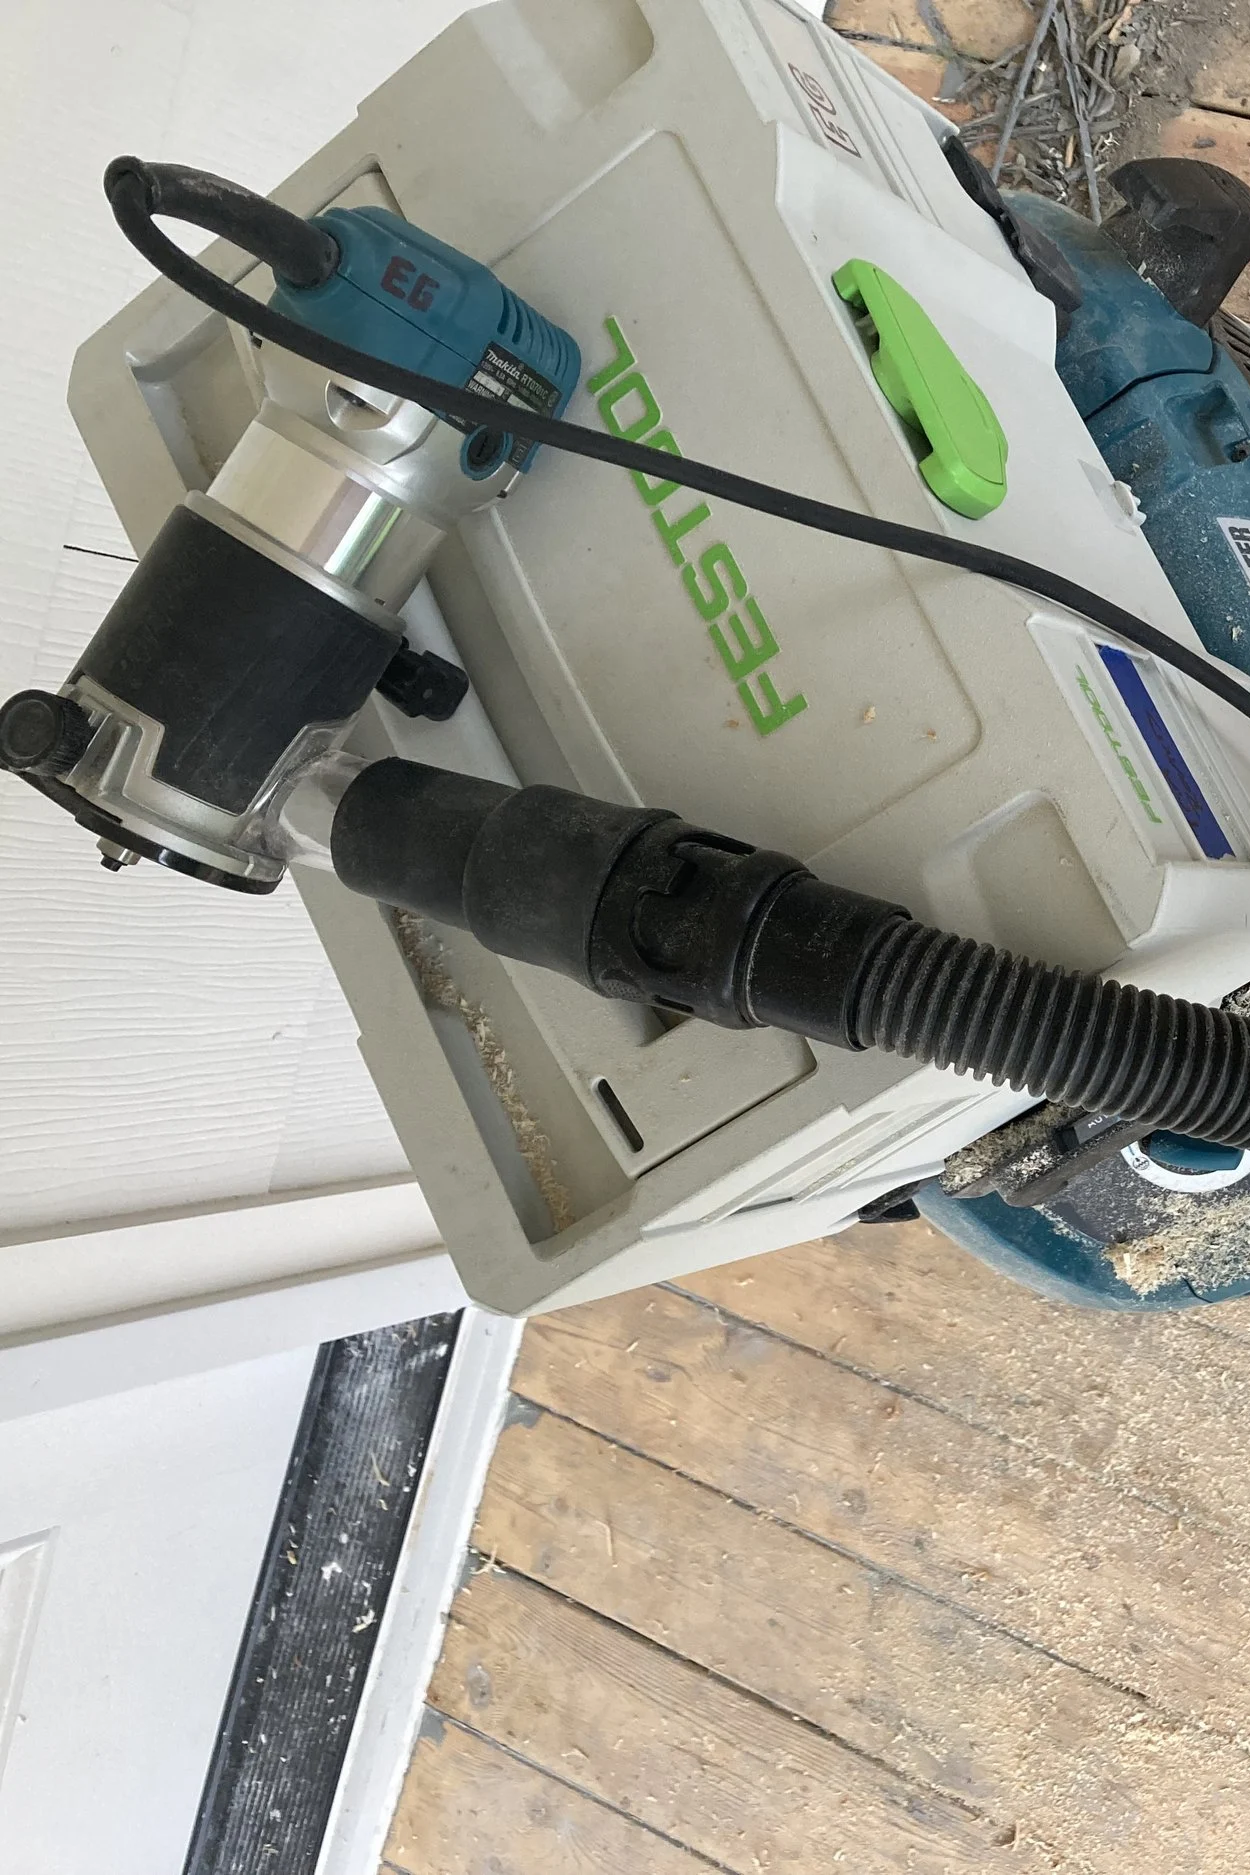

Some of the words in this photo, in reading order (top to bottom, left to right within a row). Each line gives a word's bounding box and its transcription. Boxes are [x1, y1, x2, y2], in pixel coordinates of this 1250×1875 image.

[381, 255, 440, 313] EG
[587, 315, 808, 737] FESTOOL
[1076, 664, 1163, 823] FESTOOL
